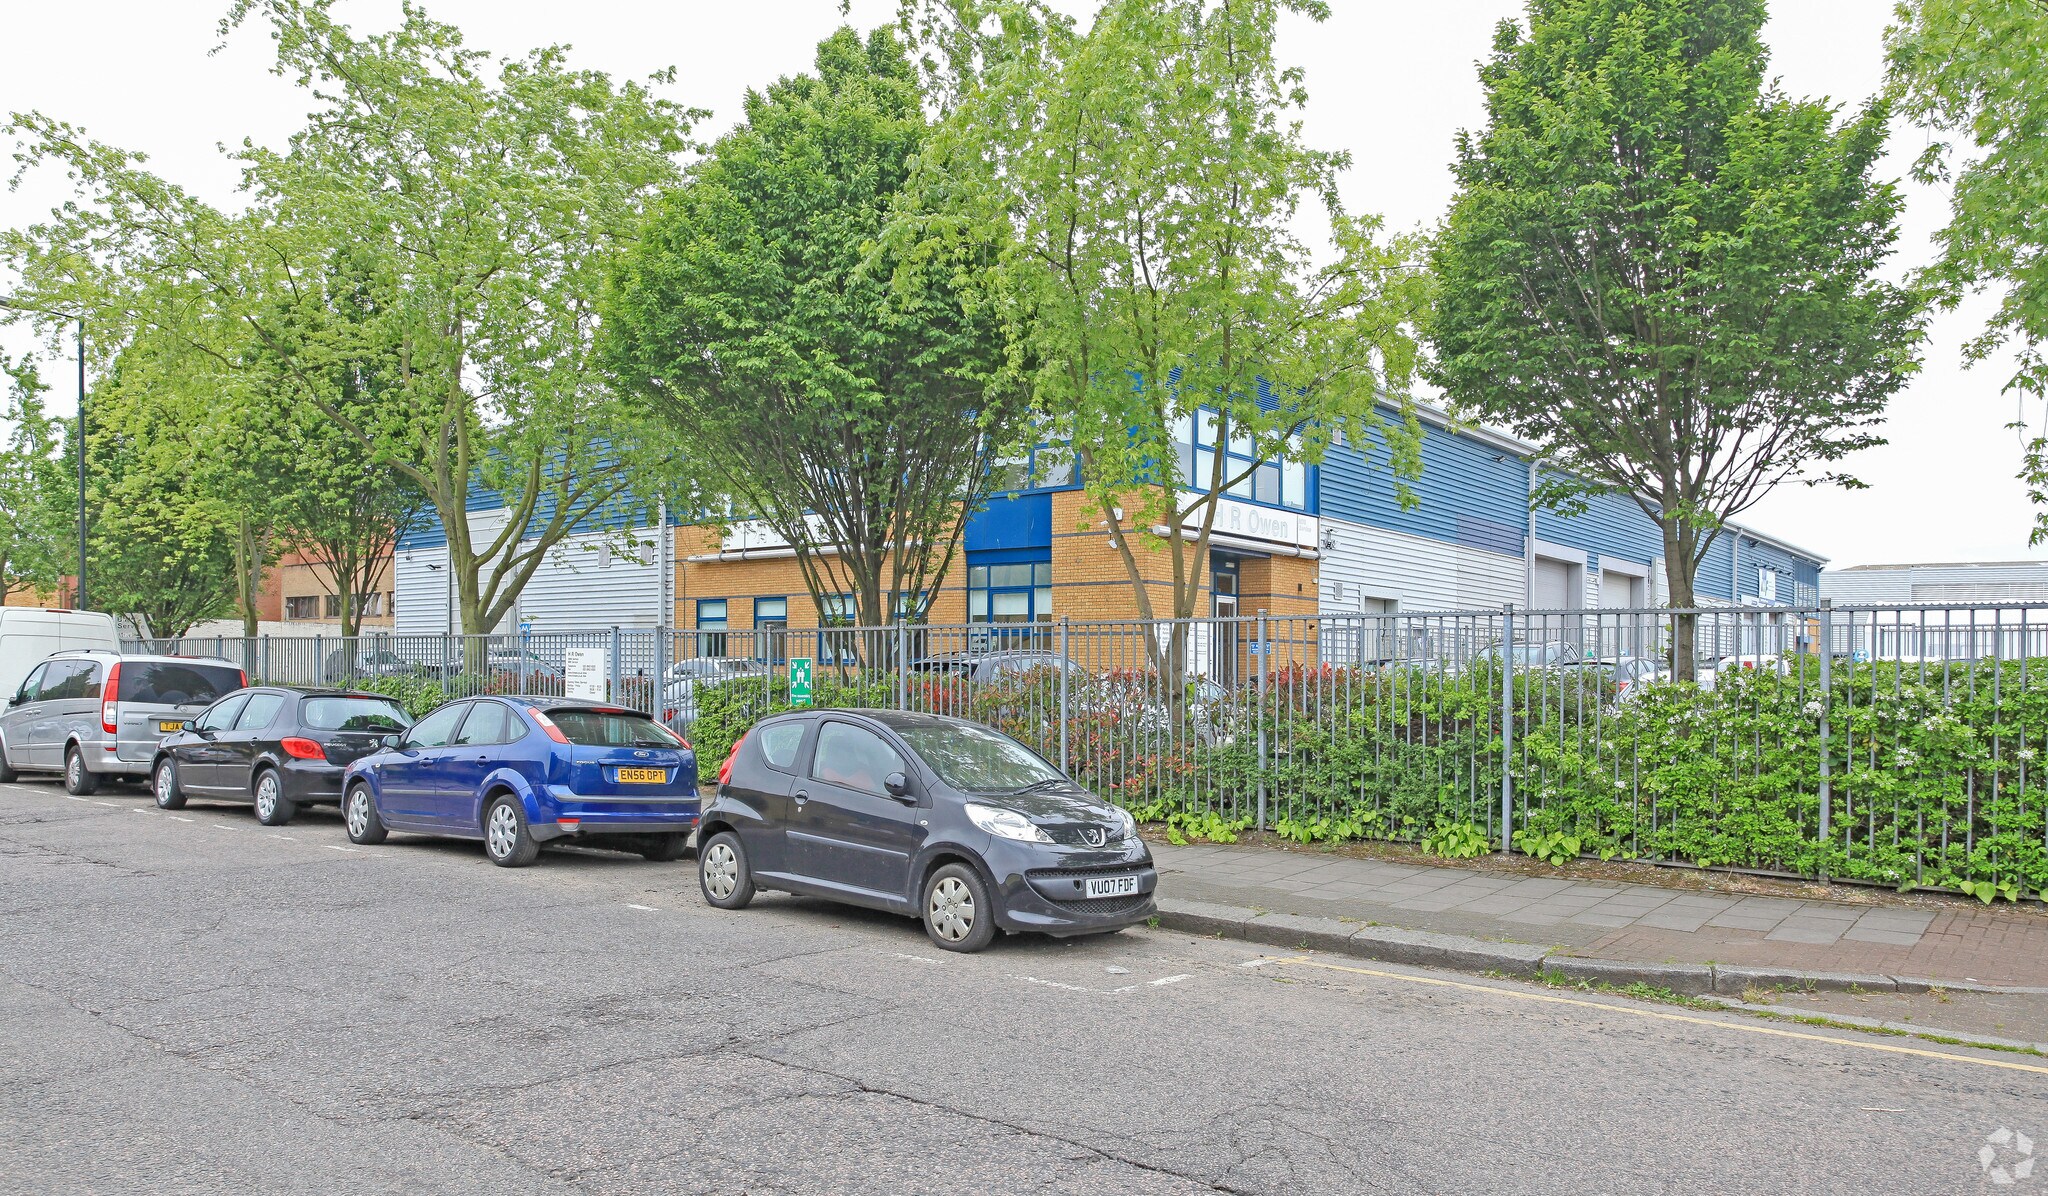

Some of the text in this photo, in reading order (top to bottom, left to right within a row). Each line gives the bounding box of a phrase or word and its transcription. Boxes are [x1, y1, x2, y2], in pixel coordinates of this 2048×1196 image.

[1213, 503, 1288, 538] H R Owen
[117, 622, 145, 630] Serve
[620, 769, 664, 781] EN56 OPT
[1091, 877, 1134, 895] VU07 FDF
